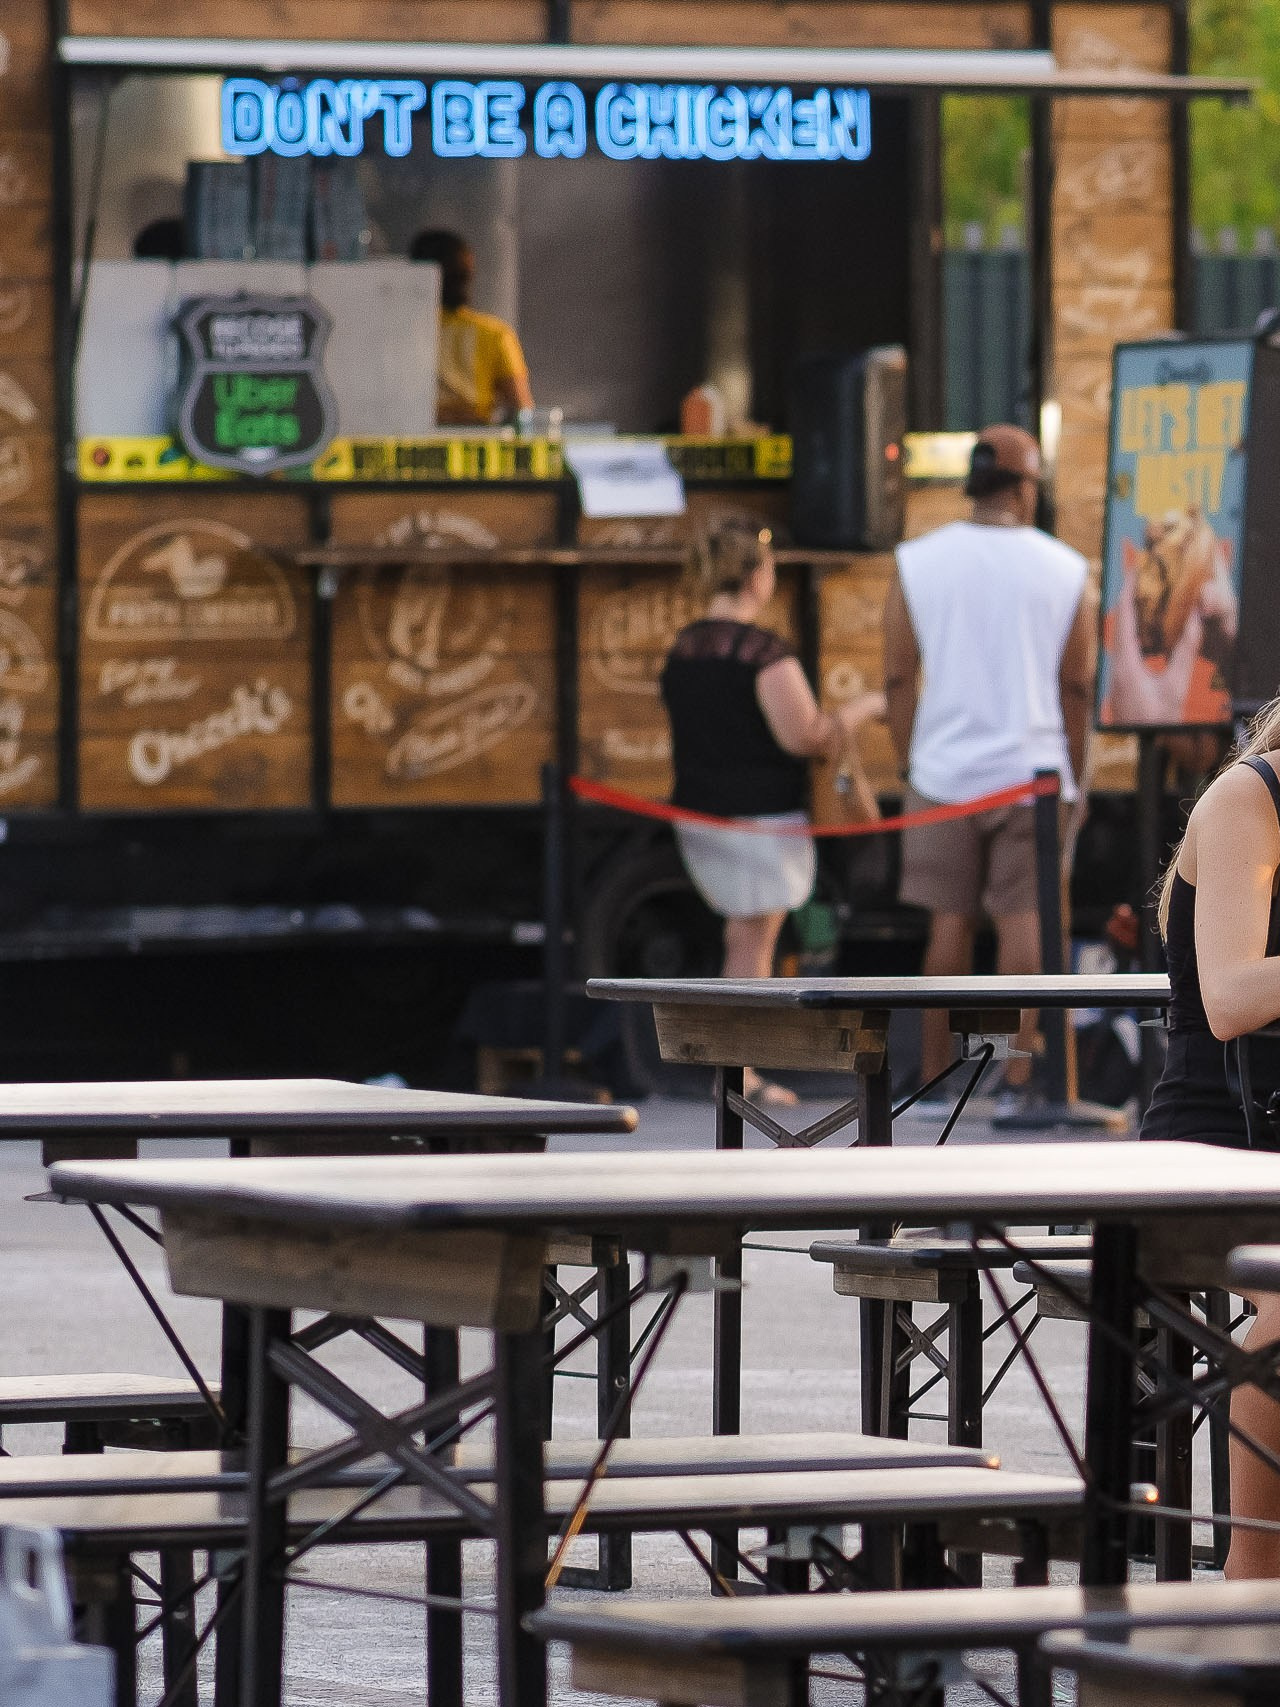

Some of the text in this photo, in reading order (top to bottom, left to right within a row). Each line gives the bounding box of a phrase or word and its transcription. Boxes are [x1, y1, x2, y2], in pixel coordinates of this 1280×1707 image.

[221, 78, 872, 160] DON'T BE A CHICKEN
[213, 374, 300, 409] Uber
[213, 409, 301, 447] Eats
